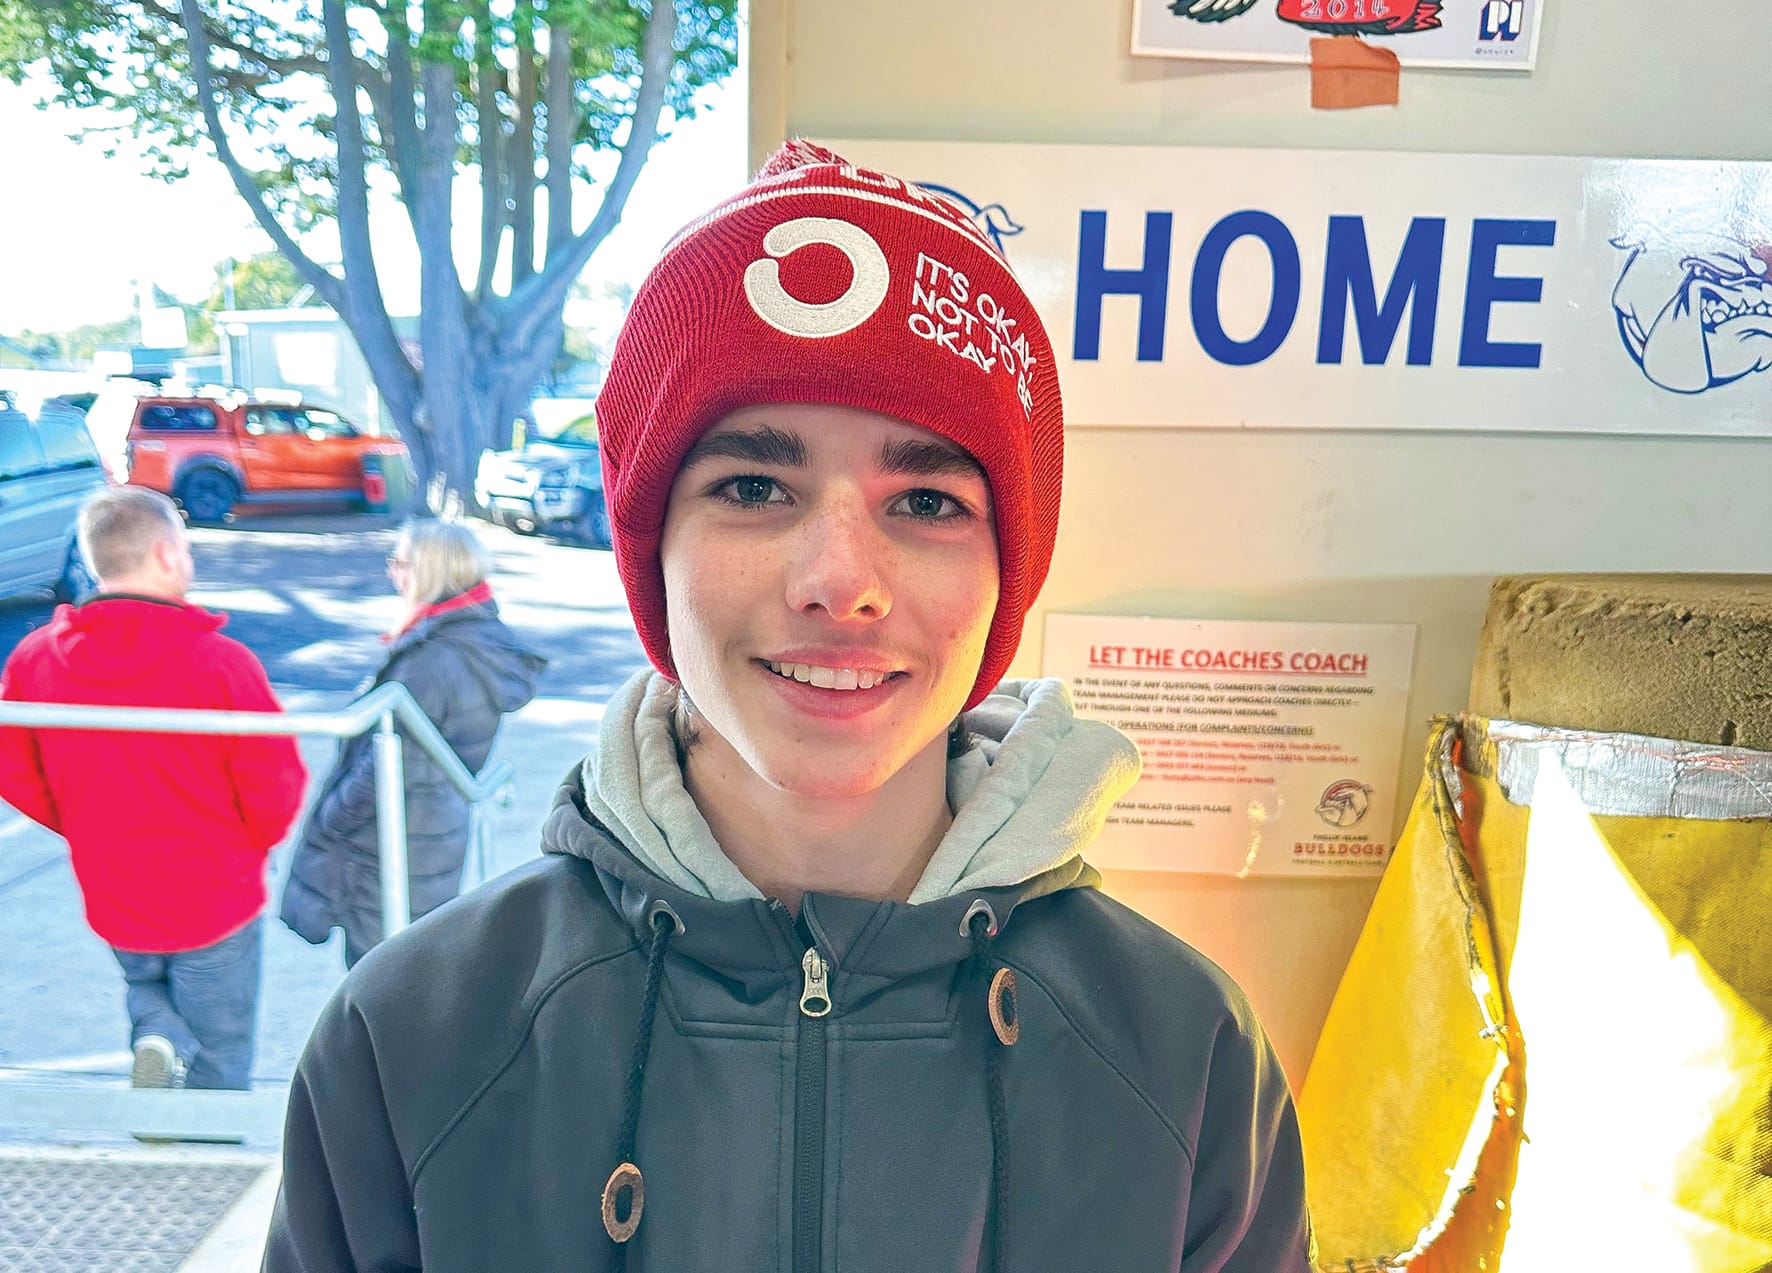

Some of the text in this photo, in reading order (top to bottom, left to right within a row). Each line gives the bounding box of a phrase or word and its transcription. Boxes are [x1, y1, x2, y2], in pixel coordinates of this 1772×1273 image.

[916, 252, 970, 303] IT'S
[1072, 209, 1556, 369] HOME
[908, 313, 997, 374] OKAY
[912, 280, 1034, 422] NOT TO BE
[1089, 645, 1369, 672] LET THE COACHES COACH
[1073, 689, 1096, 698] TEAM
[1099, 690, 1159, 701] MANAGEMENT
[1161, 693, 1190, 702] PLEASE
[1207, 695, 1225, 703] NOT
[1228, 695, 1272, 705] APPROACH
[1273, 697, 1312, 706] COACHES
[1085, 678, 1099, 686] THE
[1102, 679, 1128, 688] EVENT
[1143, 680, 1160, 689] ANY
[1214, 682, 1262, 692] COMMENTS
[1278, 684, 1323, 694] CONCERNS
[1325, 685, 1374, 695] REGARDING
[1133, 704, 1150, 713] ONE
[1166, 705, 1181, 714] THE
[1183, 706, 1232, 716] FOLLOWING
[1118, 720, 1174, 730] OPERATIONS
[1294, 842, 1384, 856] BULLDOGS
